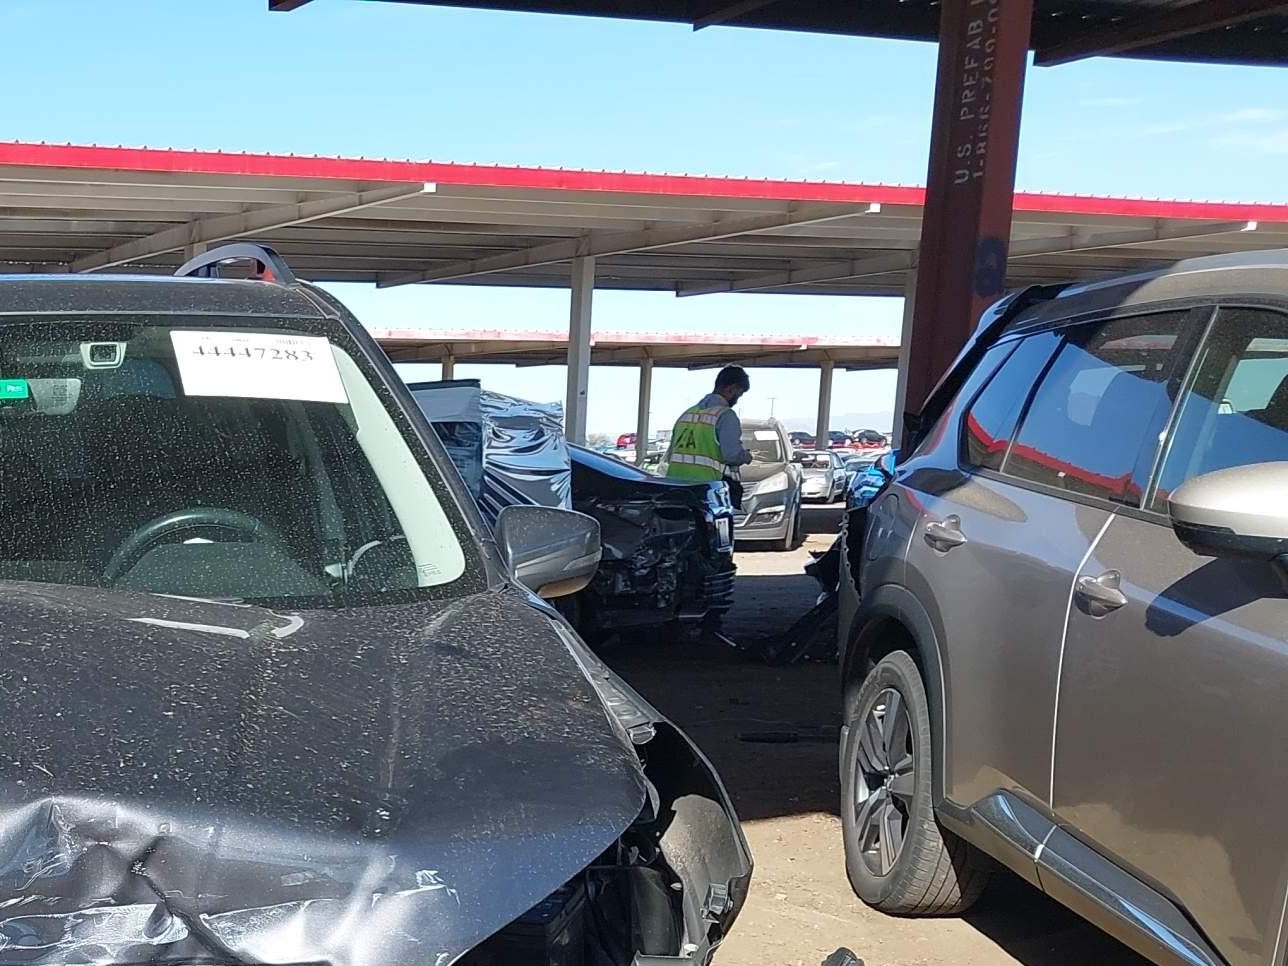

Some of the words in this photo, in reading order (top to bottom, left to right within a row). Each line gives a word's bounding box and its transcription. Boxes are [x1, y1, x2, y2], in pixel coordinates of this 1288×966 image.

[960, 19, 984, 120] PREFAB
[954, 135, 974, 184] U.S.
[192, 345, 314, 361] 44447283
